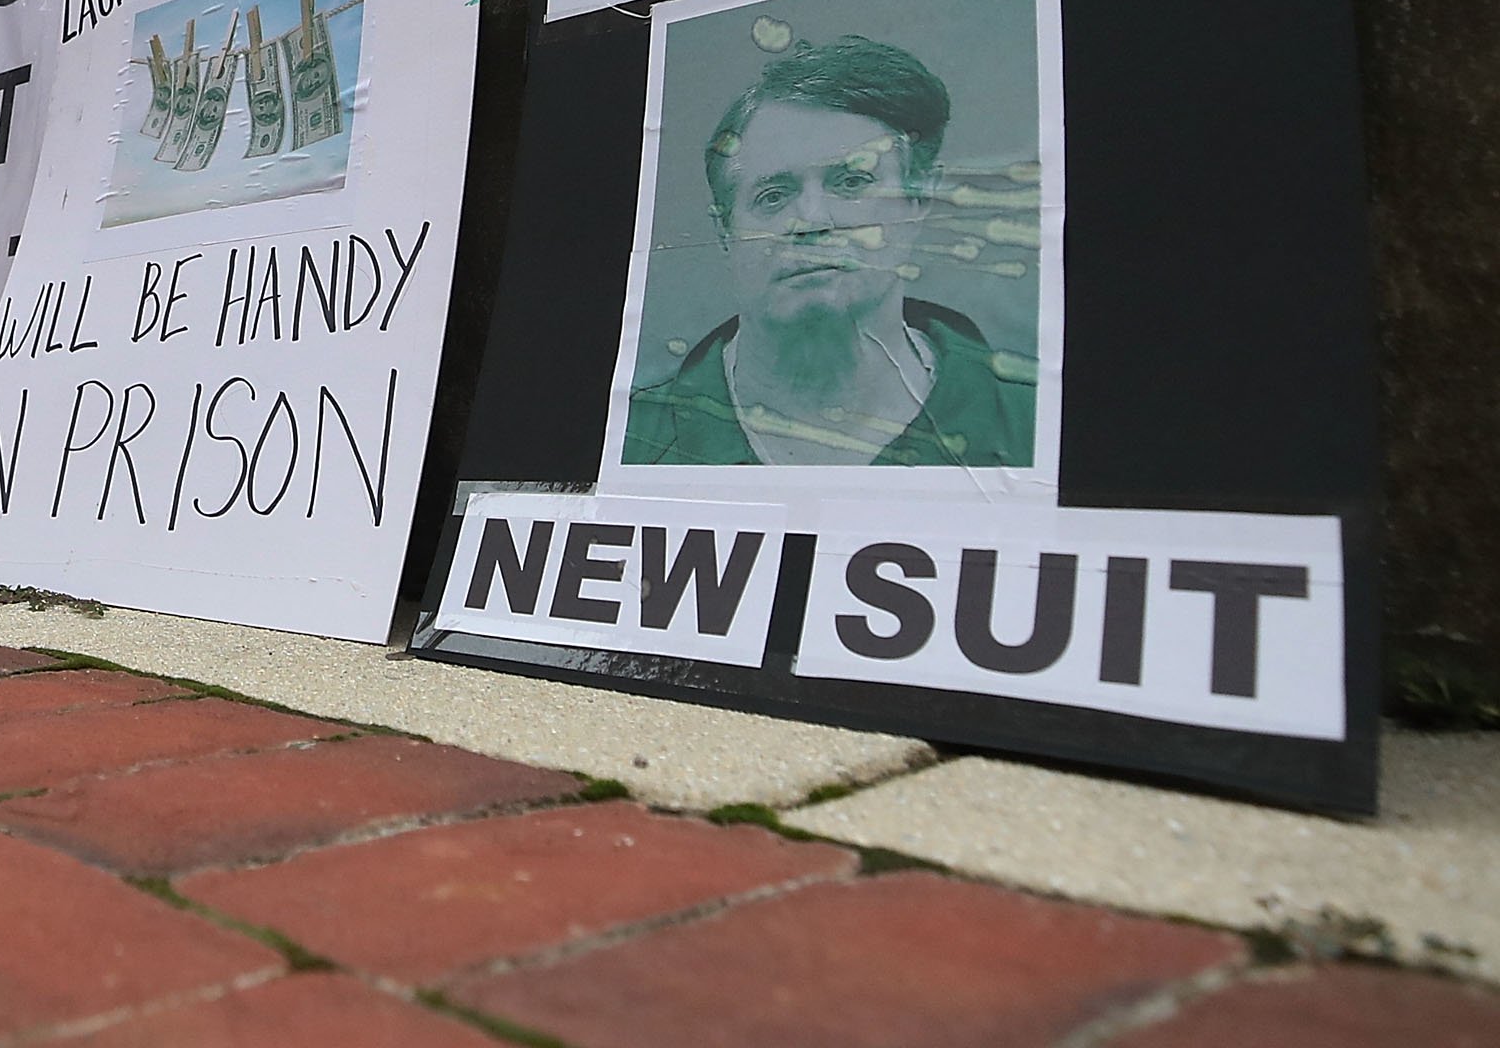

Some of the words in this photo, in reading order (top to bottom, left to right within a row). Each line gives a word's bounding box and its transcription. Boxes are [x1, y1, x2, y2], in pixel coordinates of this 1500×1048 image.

[131, 253, 204, 343] BE
[214, 221, 432, 347] HANDY
[50, 368, 399, 532] PRISON
[463, 517, 765, 638] NEW
[833, 541, 1312, 700] SUIT
